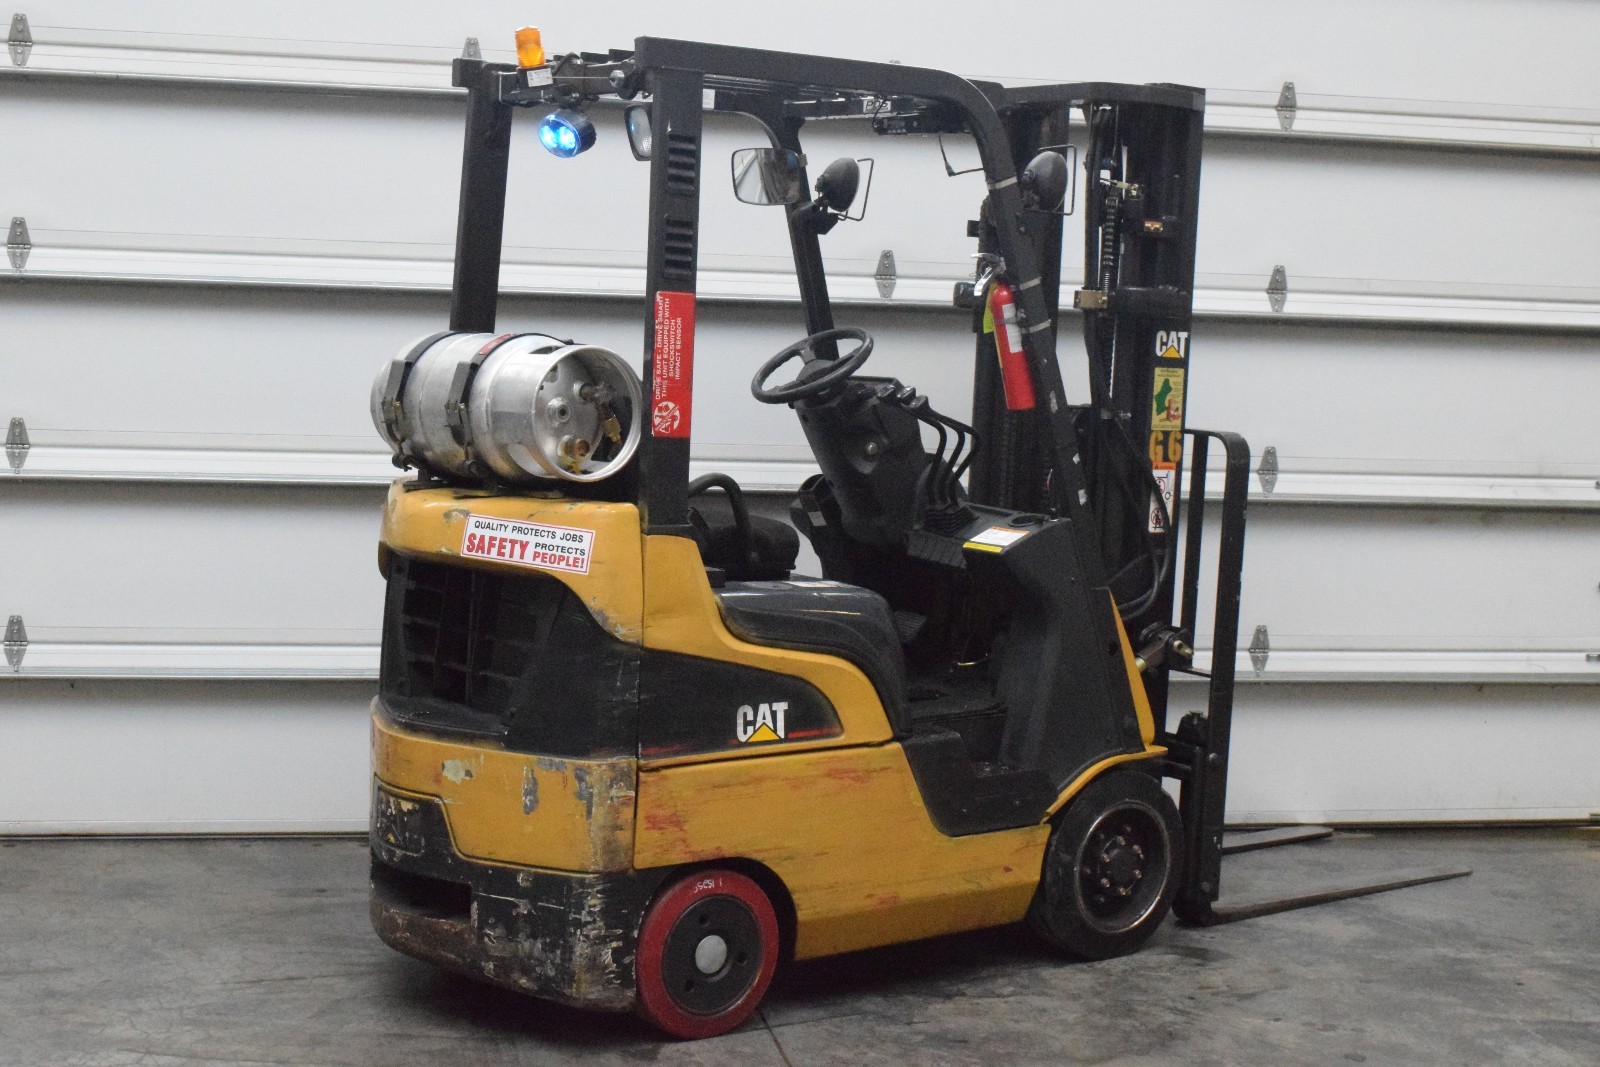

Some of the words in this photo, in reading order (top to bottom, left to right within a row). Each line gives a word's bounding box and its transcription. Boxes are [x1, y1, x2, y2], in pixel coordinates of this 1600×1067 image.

[1155, 330, 1188, 358] CAT
[474, 520, 509, 533] QUALITY
[511, 525, 557, 540] PROTECTS
[559, 532, 584, 544] JOBS
[466, 533, 530, 560] SAFETY
[534, 542, 586, 557] PROTECTS
[532, 550, 585, 569] PEOPLE!
[736, 701, 789, 742] CAT
